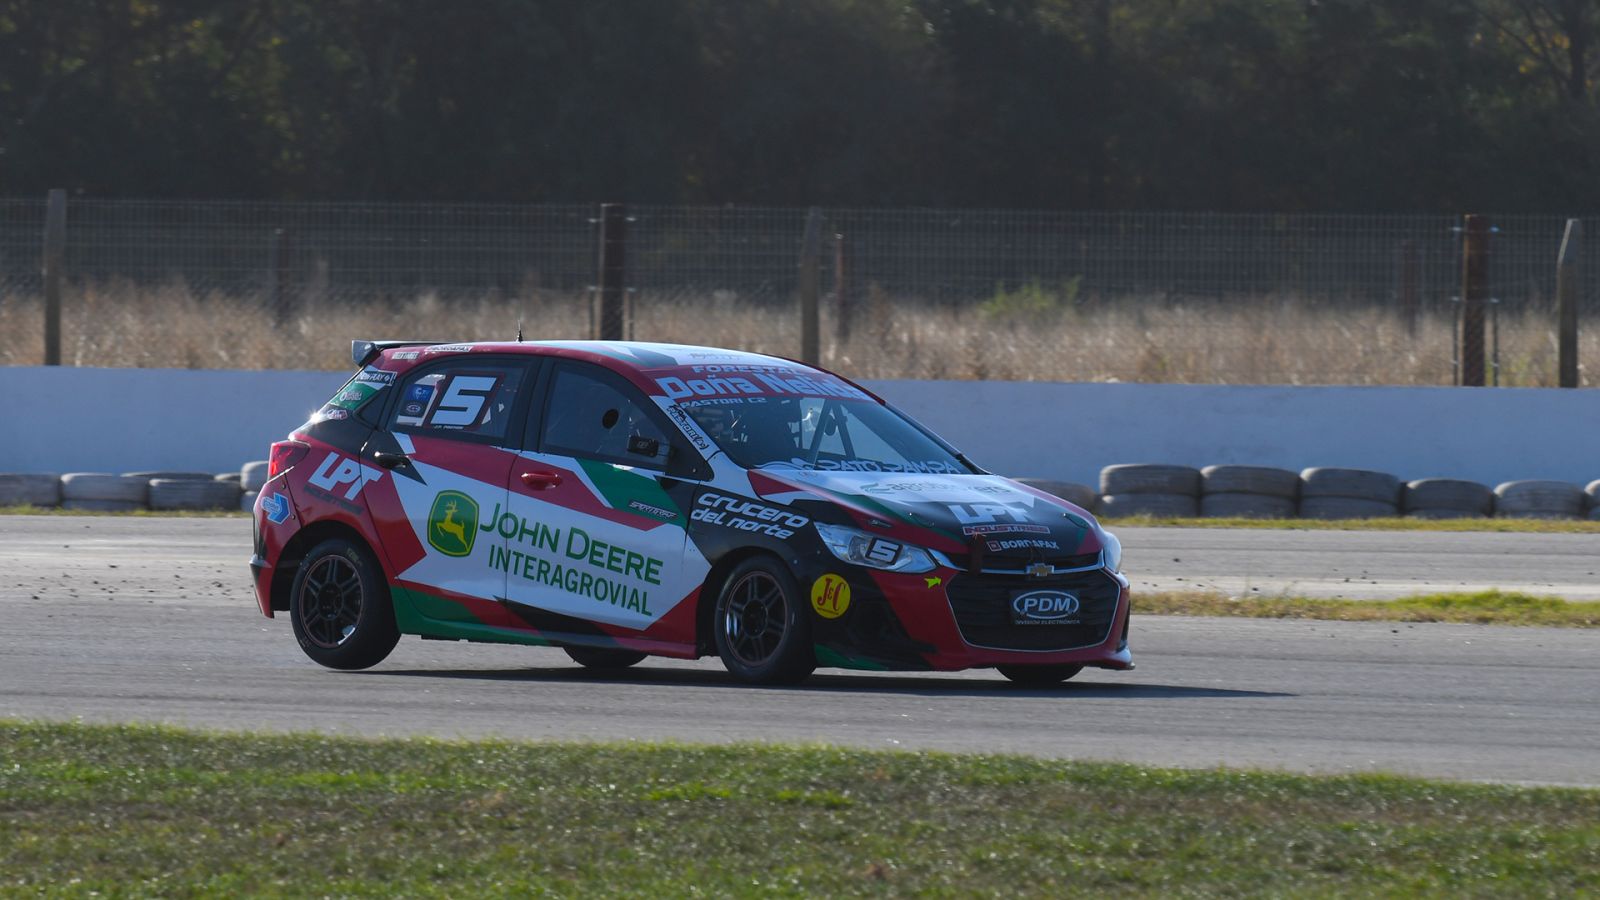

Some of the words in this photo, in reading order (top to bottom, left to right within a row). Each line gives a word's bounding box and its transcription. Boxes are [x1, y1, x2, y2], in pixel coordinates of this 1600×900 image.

[655, 374, 763, 400] Doña
[430, 375, 497, 425] 5
[680, 397, 743, 408] PASTORI
[308, 451, 384, 501] LPT
[727, 517, 794, 540] norte
[869, 540, 899, 562] 5
[489, 545, 652, 616] INTERAGROVIAL
[1025, 598, 1071, 611] PDM
